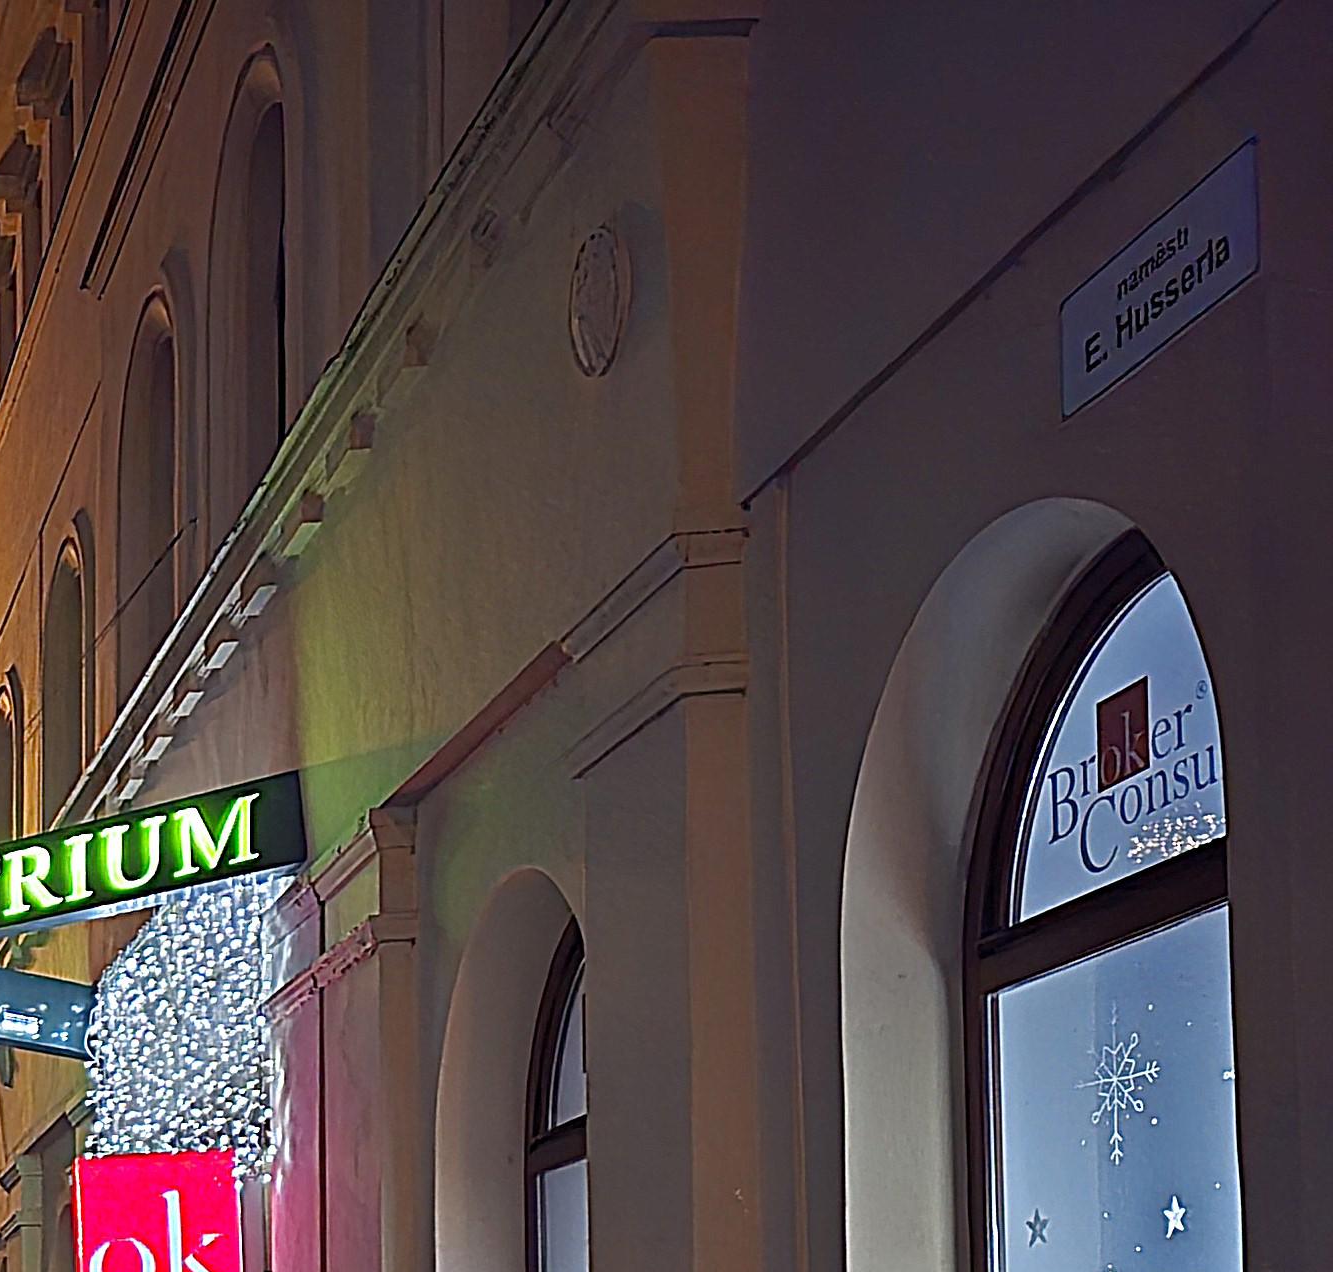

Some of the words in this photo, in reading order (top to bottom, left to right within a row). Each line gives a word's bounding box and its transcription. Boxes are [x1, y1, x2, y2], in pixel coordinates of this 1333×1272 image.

[1085, 331, 1109, 373] E.
[1116, 235, 1230, 349] Husserla
[1048, 704, 1193, 845] Broker
